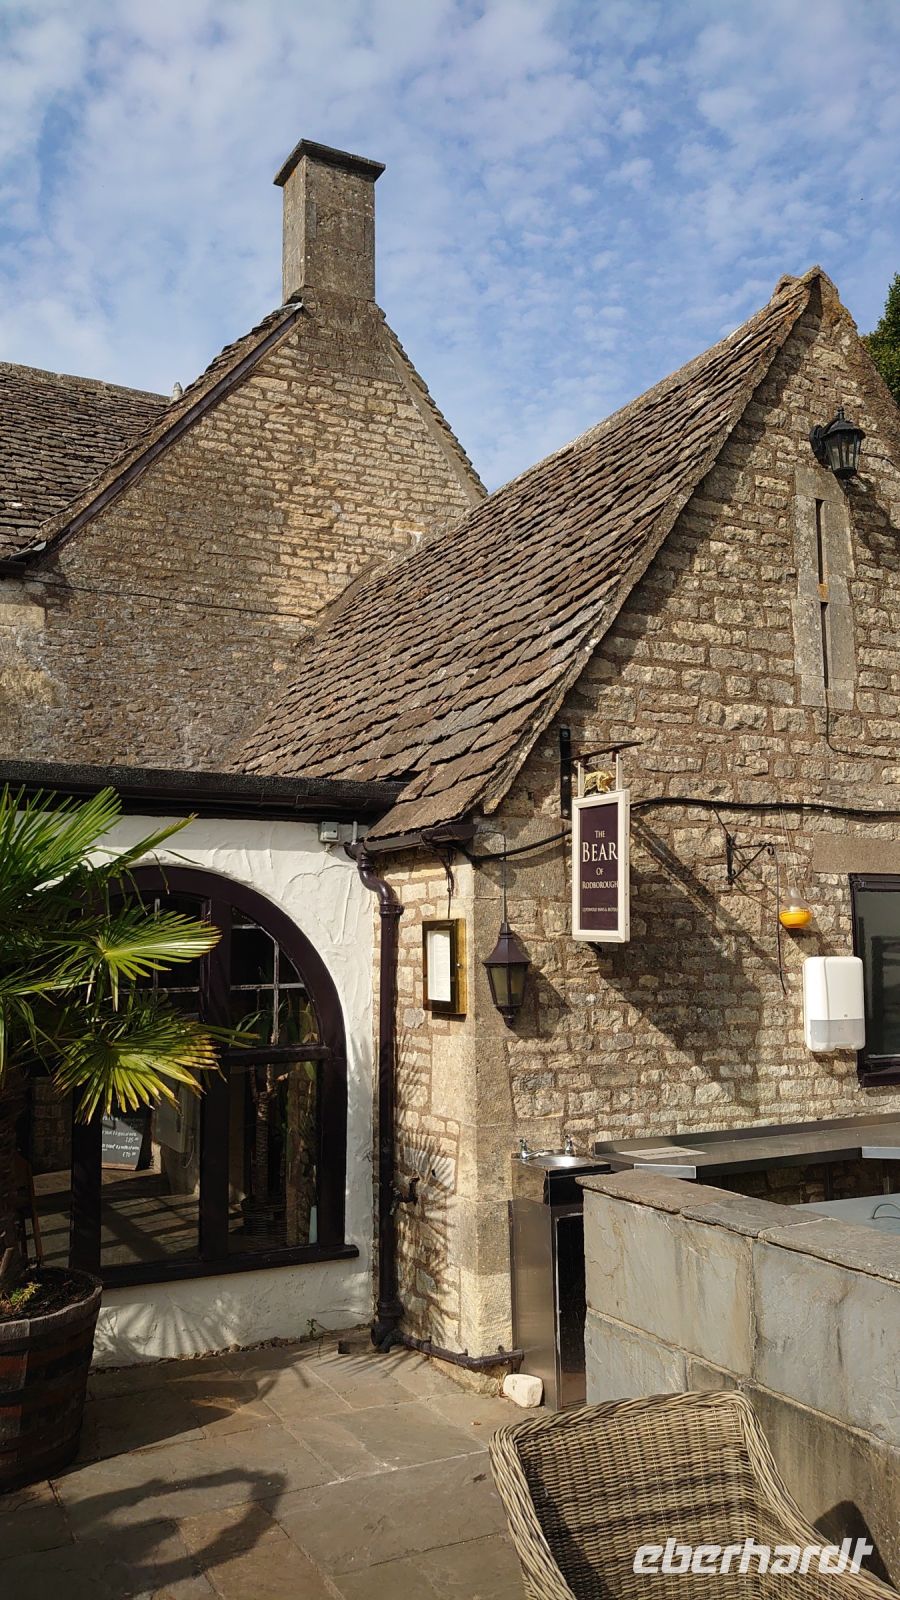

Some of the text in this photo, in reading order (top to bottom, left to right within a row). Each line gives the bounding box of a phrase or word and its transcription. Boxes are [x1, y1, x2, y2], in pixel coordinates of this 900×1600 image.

[594, 830, 606, 839] THE
[582, 842, 618, 862] BEAR
[595, 867, 604, 876] OF
